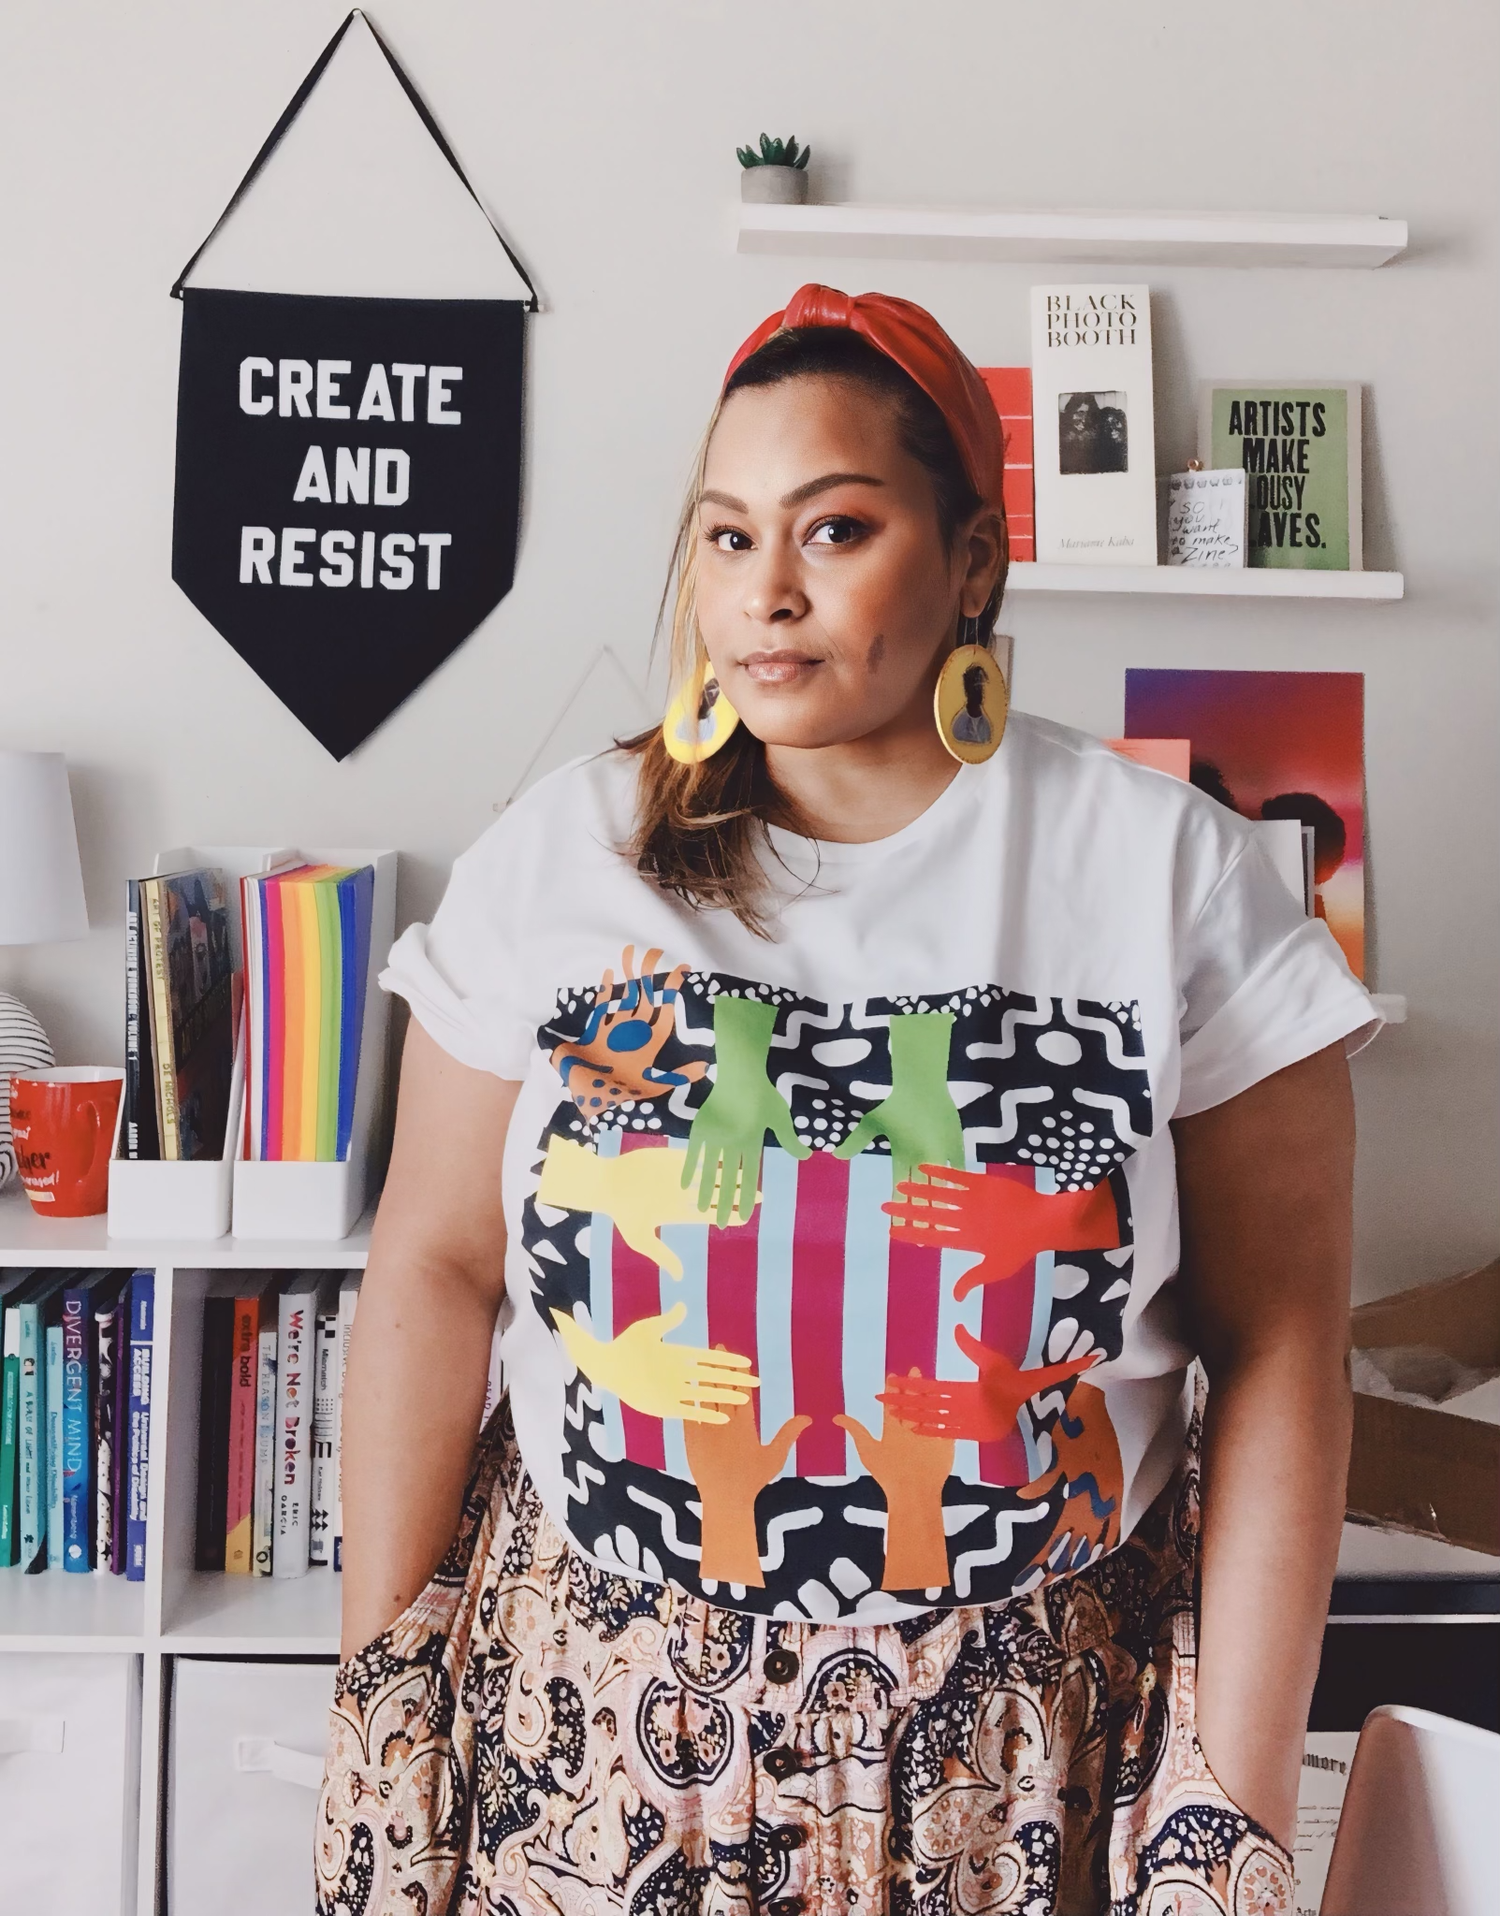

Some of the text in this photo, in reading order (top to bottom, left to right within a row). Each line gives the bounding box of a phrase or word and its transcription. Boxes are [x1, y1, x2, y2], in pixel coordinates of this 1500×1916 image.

[1047, 294, 1136, 312] BLACK
[1047, 311, 1137, 330] PHOTO
[1047, 328, 1136, 347] BOOTH
[238, 356, 463, 425] CREATE
[1229, 401, 1327, 437] ARTISTS
[293, 445, 411, 506] AND
[1242, 437, 1310, 474] MAKE
[1250, 474, 1306, 511] OUSY
[239, 526, 452, 590] RESIST
[153, 922, 163, 933] OF
[155, 937, 165, 981] PROTEST
[66, 1300, 82, 1472] DIVERGENT MIND
[132, 1348, 142, 1398] ACCESS
[240, 1355, 252, 1388] bold
[261, 1373, 270, 1421] REASON
[284, 1310, 304, 1486] We're Not Broken
